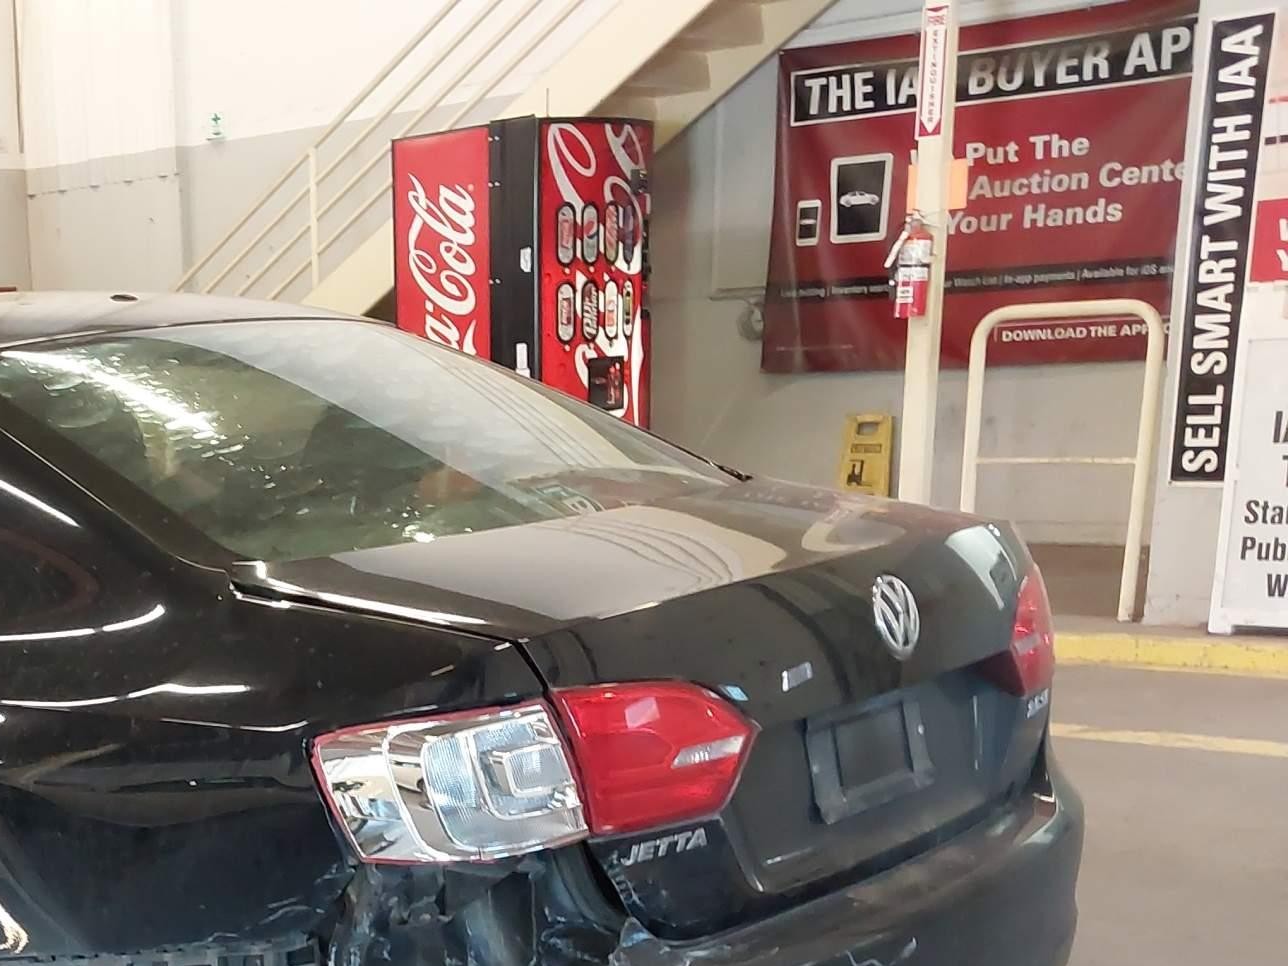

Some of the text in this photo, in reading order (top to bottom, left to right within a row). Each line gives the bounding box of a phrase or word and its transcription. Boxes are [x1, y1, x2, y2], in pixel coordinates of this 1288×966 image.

[804, 24, 1199, 115] THE IA BUYER AP
[966, 133, 1090, 166] Put The
[968, 159, 1185, 200] Auction Cente
[947, 198, 1123, 235] Your Hands
[1181, 24, 1263, 473] SELL SMART WITH IAA
[1081, 266, 1124, 279] Available
[1001, 325, 1088, 342] DOWNLOAD
[1089, 325, 1117, 338] THE
[1244, 499, 1288, 526] Sta
[1240, 535, 1288, 562] Pub
[620, 827, 708, 866] JETTA
